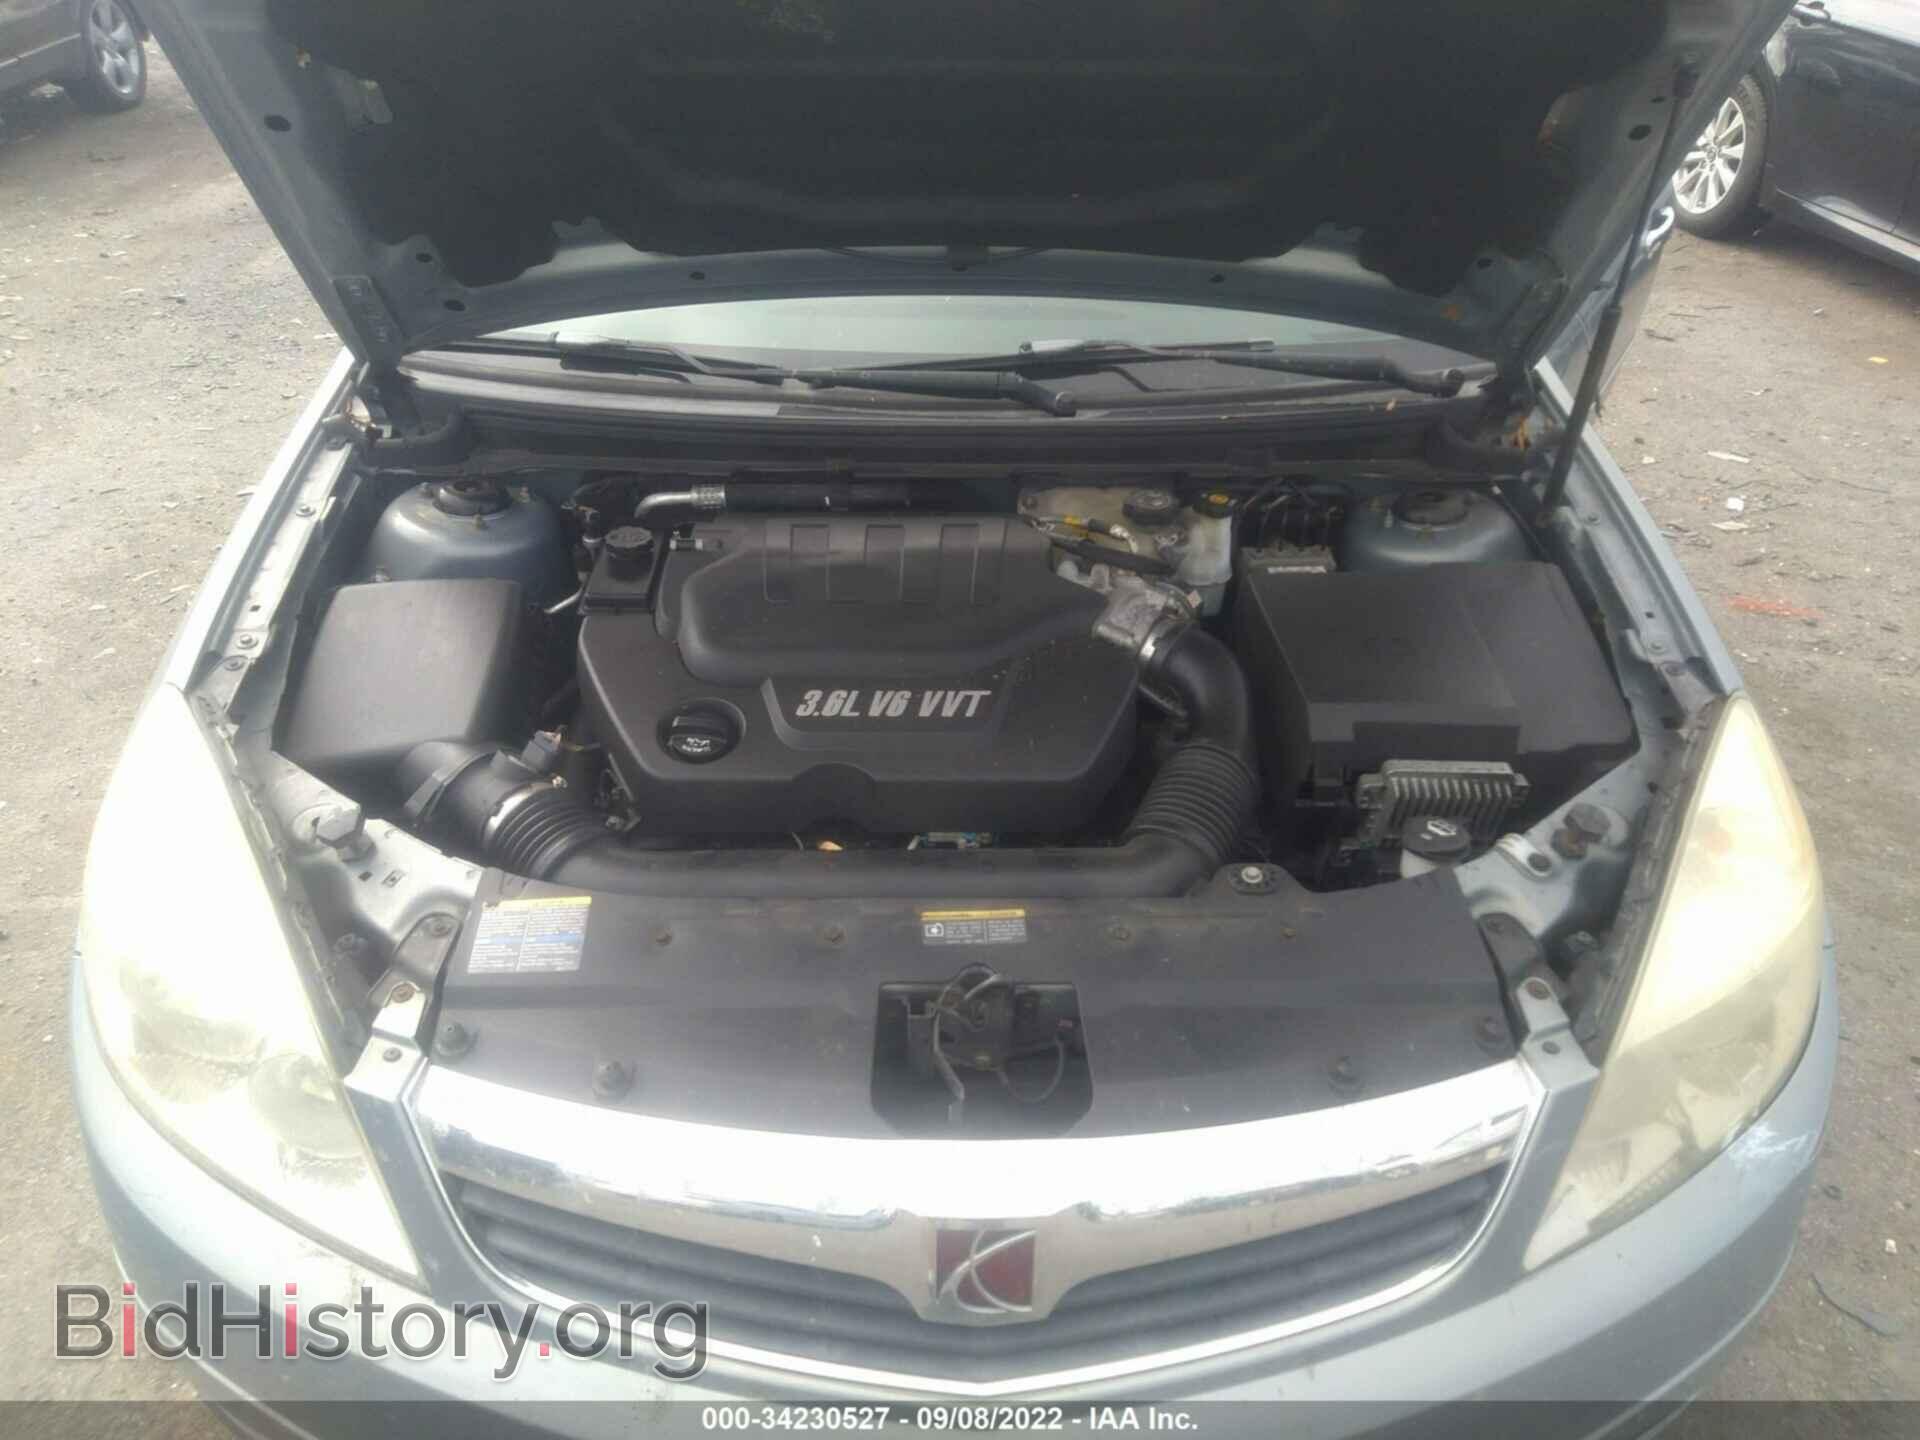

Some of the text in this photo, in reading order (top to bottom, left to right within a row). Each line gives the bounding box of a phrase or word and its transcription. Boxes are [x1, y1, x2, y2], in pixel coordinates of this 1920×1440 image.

[795, 690, 992, 717] 3.6L V6 VVT
